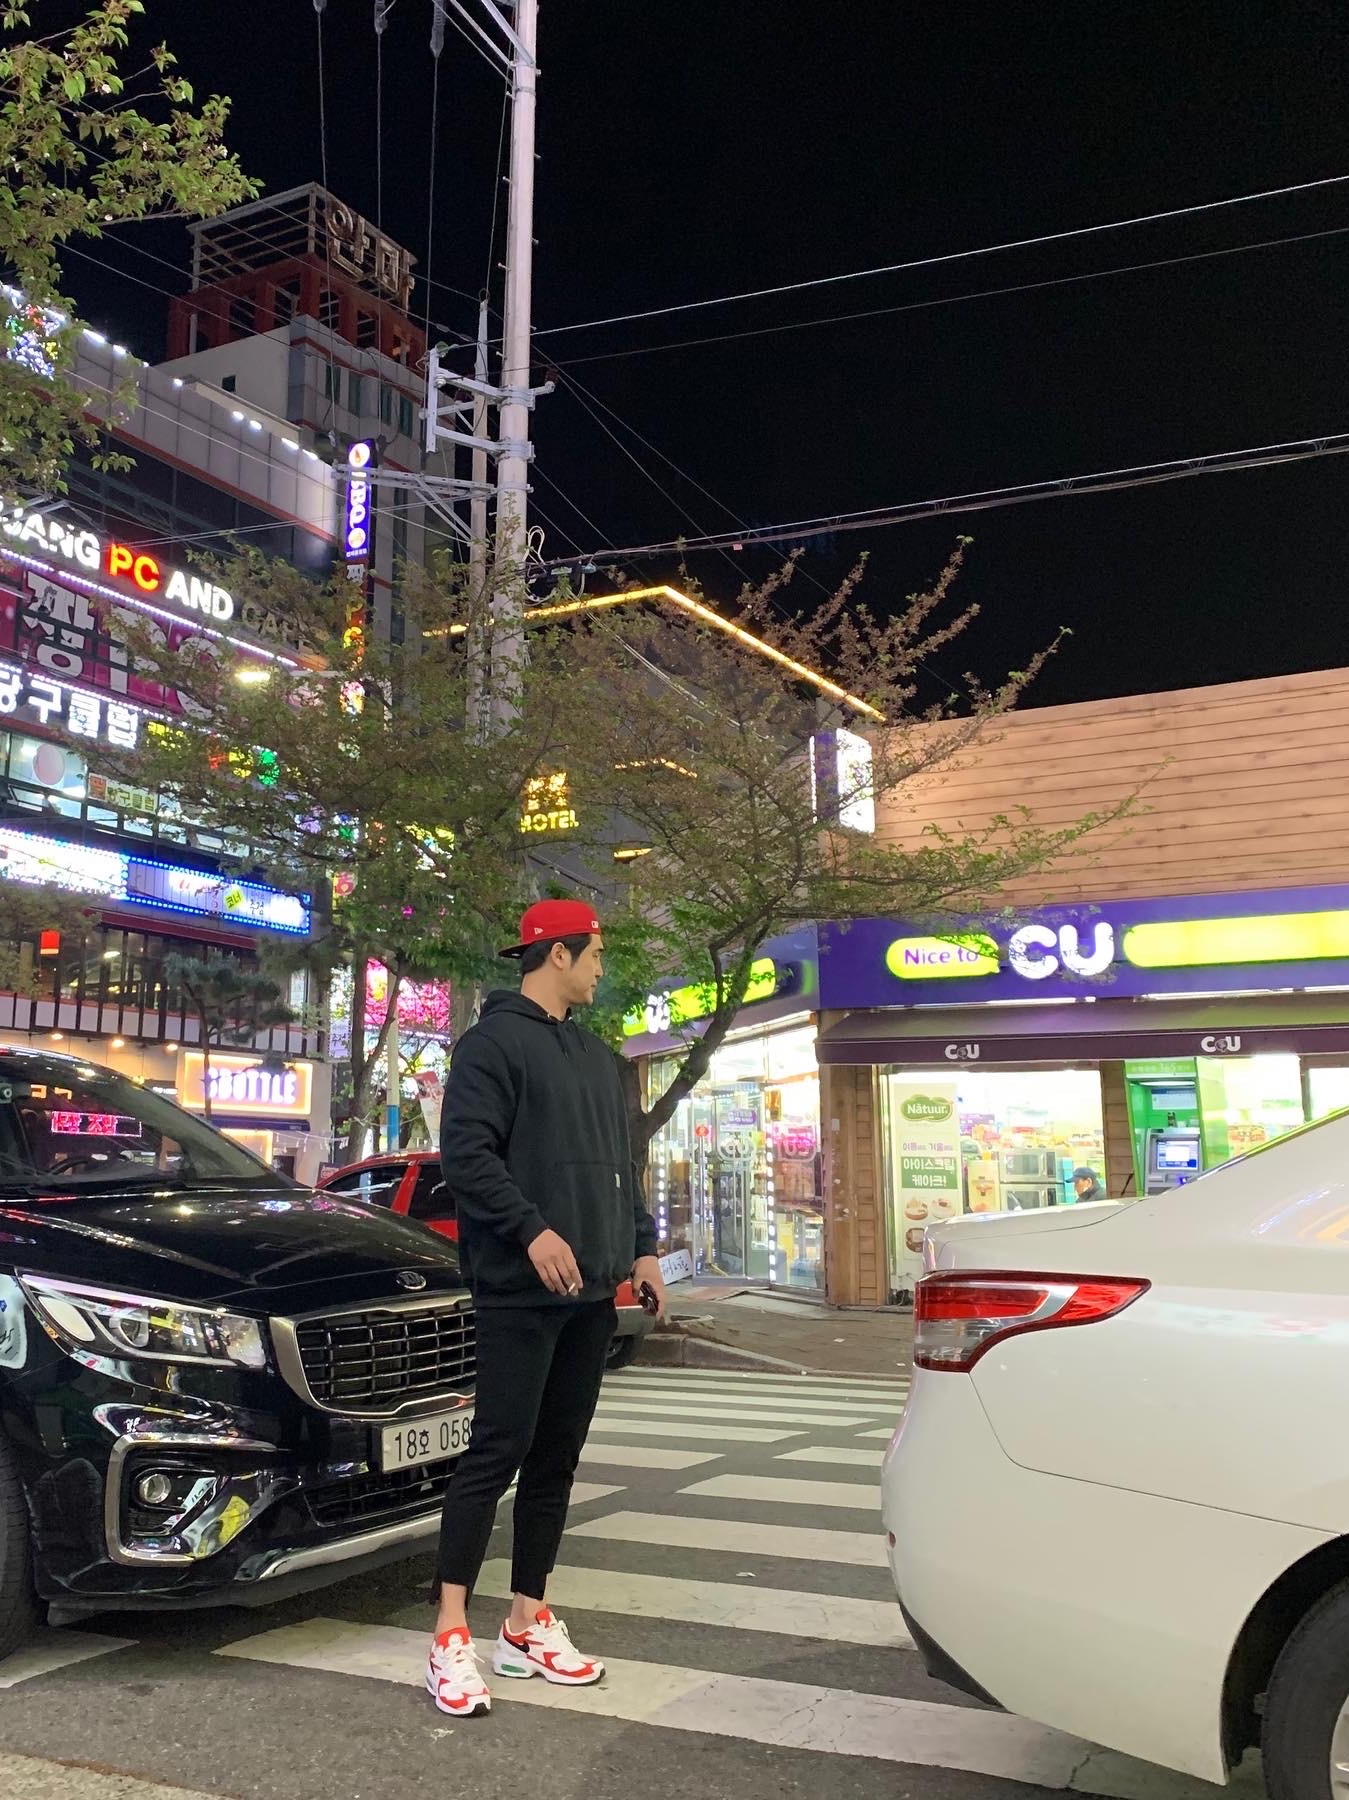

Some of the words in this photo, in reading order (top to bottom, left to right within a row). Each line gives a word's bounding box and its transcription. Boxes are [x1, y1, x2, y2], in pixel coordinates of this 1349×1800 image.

[108, 542, 161, 592] PC
[164, 569, 235, 621] AND
[904, 948, 951, 966] Nice
[957, 949, 979, 963] to
[1008, 922, 1114, 980] CU
[945, 1043, 980, 1060] CU
[1201, 1035, 1241, 1054] CU
[903, 1158, 955, 1171] 아이스크림
[912, 1174, 947, 1187] 케이크!
[394, 1427, 430, 1462] 18호
[439, 1416, 470, 1451] 058
